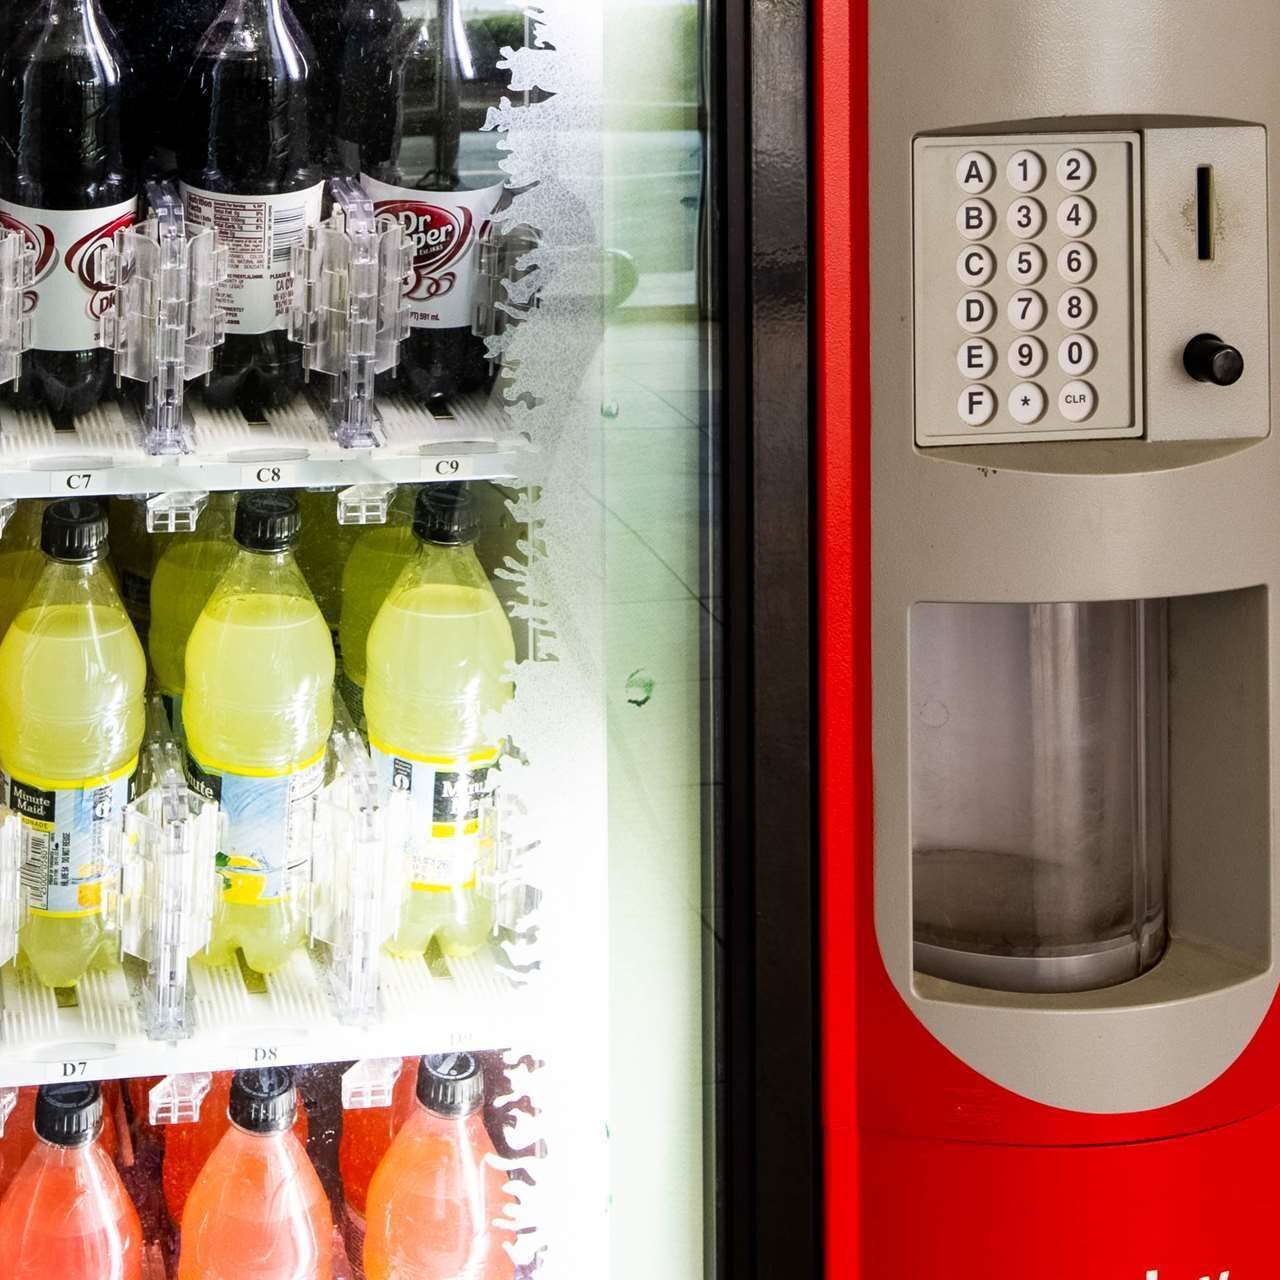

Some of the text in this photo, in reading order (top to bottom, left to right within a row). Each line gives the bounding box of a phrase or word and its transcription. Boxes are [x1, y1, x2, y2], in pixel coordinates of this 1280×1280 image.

[963, 157, 1081, 184] A 1 2
[965, 203, 1082, 230] B 3 4
[964, 249, 1082, 277] C 5 6
[965, 295, 1083, 323] D 7 8
[967, 341, 1083, 369] E 9 0
[968, 391, 1087, 415] F CLR
[256, 467, 281, 483] C8
[435, 460, 460, 474] C9
[66, 473, 92, 490] C7
[12, 786, 51, 806] Minute
[18, 800, 46, 816] Maid
[254, 1047, 278, 1062] D8
[63, 1061, 87, 1077] D7
